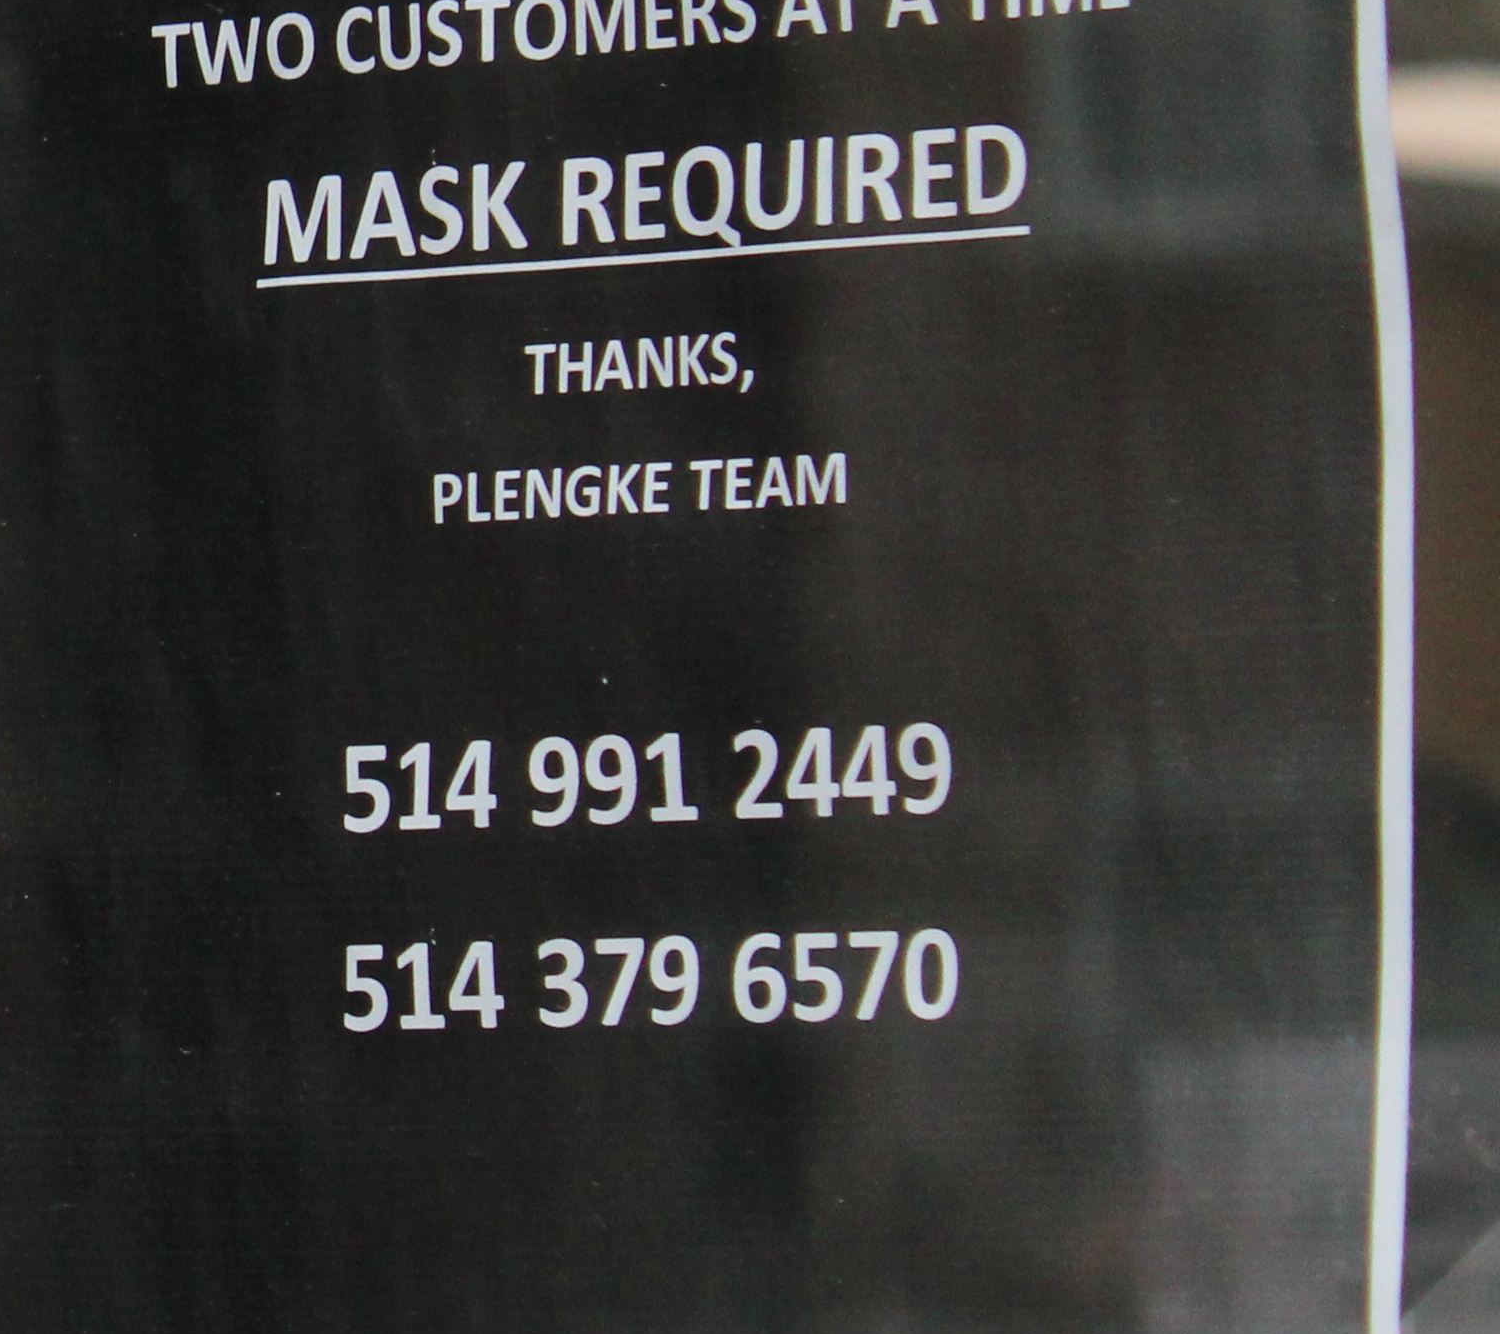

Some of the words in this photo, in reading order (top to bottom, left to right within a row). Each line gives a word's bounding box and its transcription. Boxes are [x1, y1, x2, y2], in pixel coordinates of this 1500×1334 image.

[152, 13, 314, 88] TWO
[264, 162, 530, 270] MASK
[562, 125, 1030, 254] REQUIRED
[525, 332, 753, 394] THANKS,
[434, 462, 672, 524] PLENGKE
[690, 453, 846, 510] TEAM
[344, 740, 496, 833] 514
[529, 733, 698, 826] 991
[734, 723, 951, 819] 2449
[344, 941, 504, 1031] 514
[538, 936, 699, 1027] 379
[733, 929, 958, 1023] 6570
